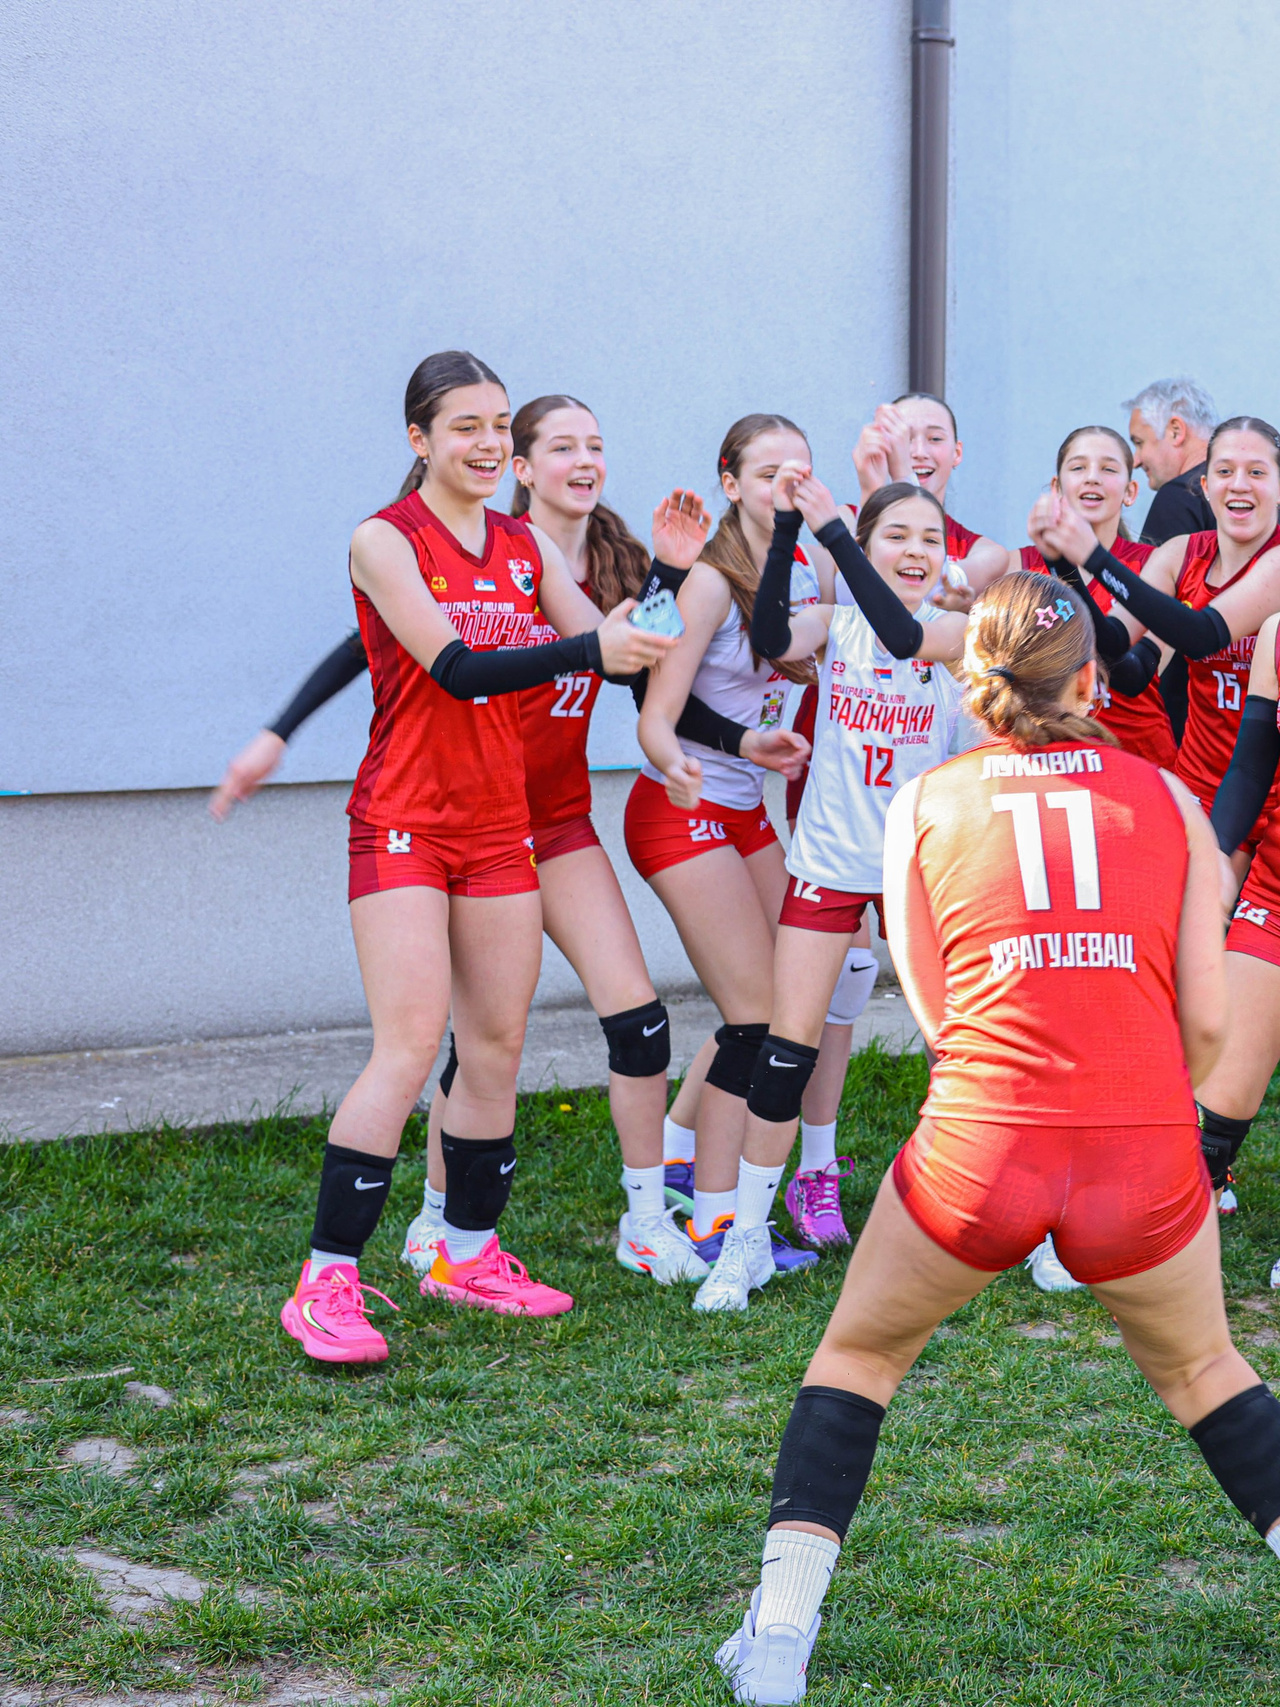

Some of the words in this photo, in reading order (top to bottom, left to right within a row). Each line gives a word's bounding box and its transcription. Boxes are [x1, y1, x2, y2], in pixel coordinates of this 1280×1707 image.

[550, 676, 591, 717] 22
[1212, 670, 1240, 711] 15
[829, 694, 935, 734] РАДНИЧКИ
[862, 744, 894, 787] 12
[979, 749, 1103, 780] ЛУКОВИЋ
[991, 789, 1101, 911] 11
